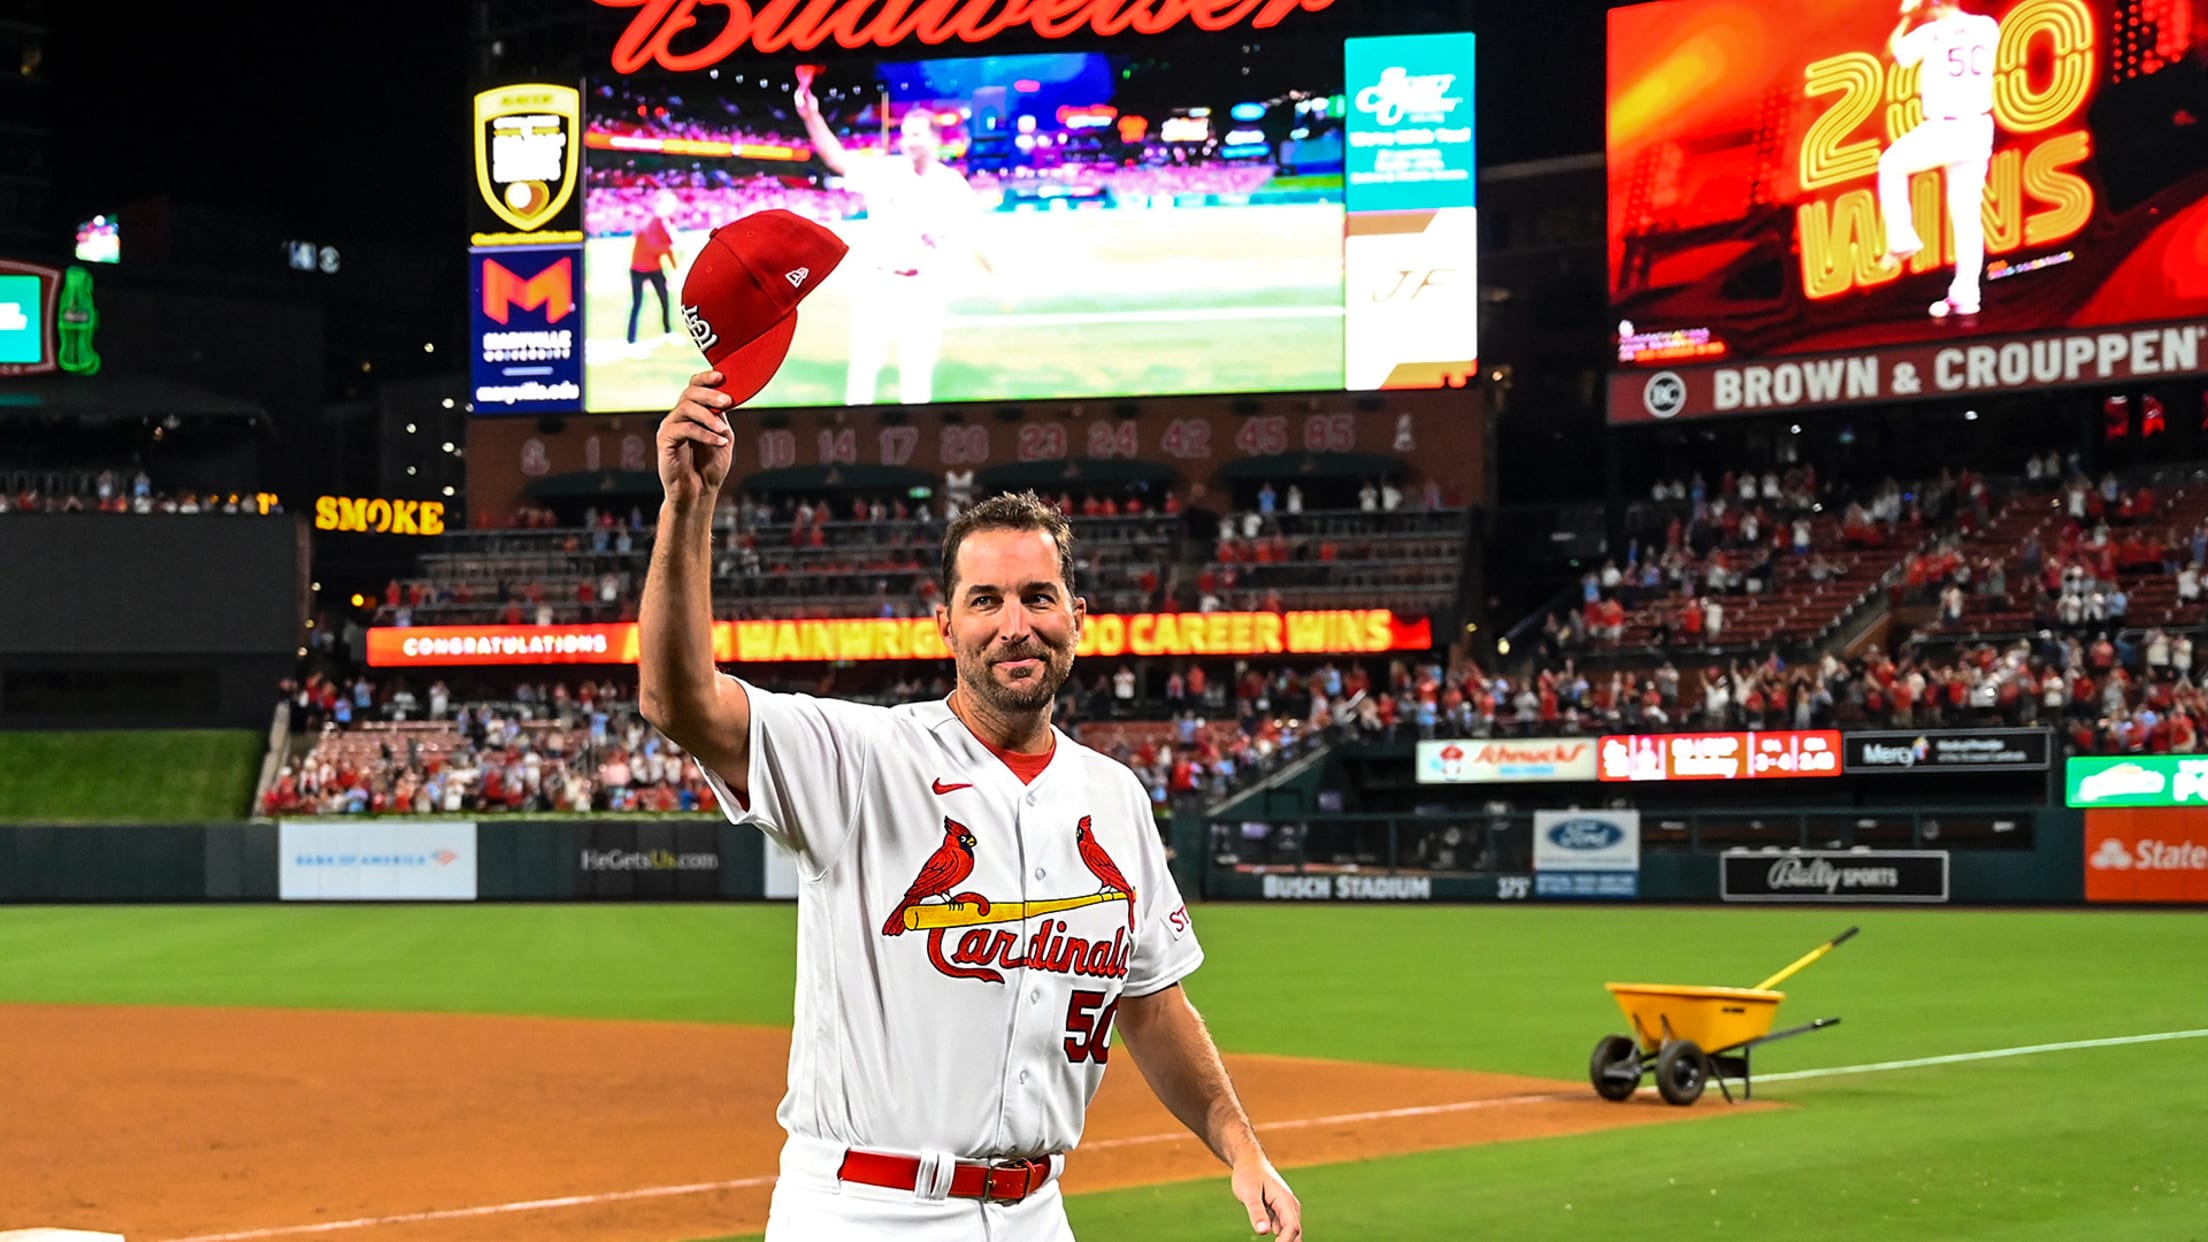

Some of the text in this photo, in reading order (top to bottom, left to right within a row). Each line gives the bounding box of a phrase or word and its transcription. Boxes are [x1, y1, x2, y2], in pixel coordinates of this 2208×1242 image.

[1798, 130, 2094, 299] WINS
[1713, 326, 2198, 411] BROWN & CROUPPEN
[758, 429, 796, 469] 10
[817, 427, 857, 466] 14
[880, 426, 919, 466] 17
[1017, 422, 1067, 462] 23
[1087, 419, 1138, 458] 24
[1235, 415, 1287, 455] 45
[1304, 413, 1355, 453] 85
[315, 496, 445, 535] SMOKE
[403, 634, 607, 657] CONGRATULATIONS
[1130, 611, 1283, 655] CAREER
[1284, 609, 1393, 653] WINS
[1862, 742, 1915, 768] Mercy
[580, 849, 719, 871] HeGetsUs.com
[2135, 839, 2208, 870] State
[1263, 875, 1431, 899] BUSCH STADIUM
[1842, 867, 1899, 887] SPORTS
[927, 896, 1130, 985] Cardinals
